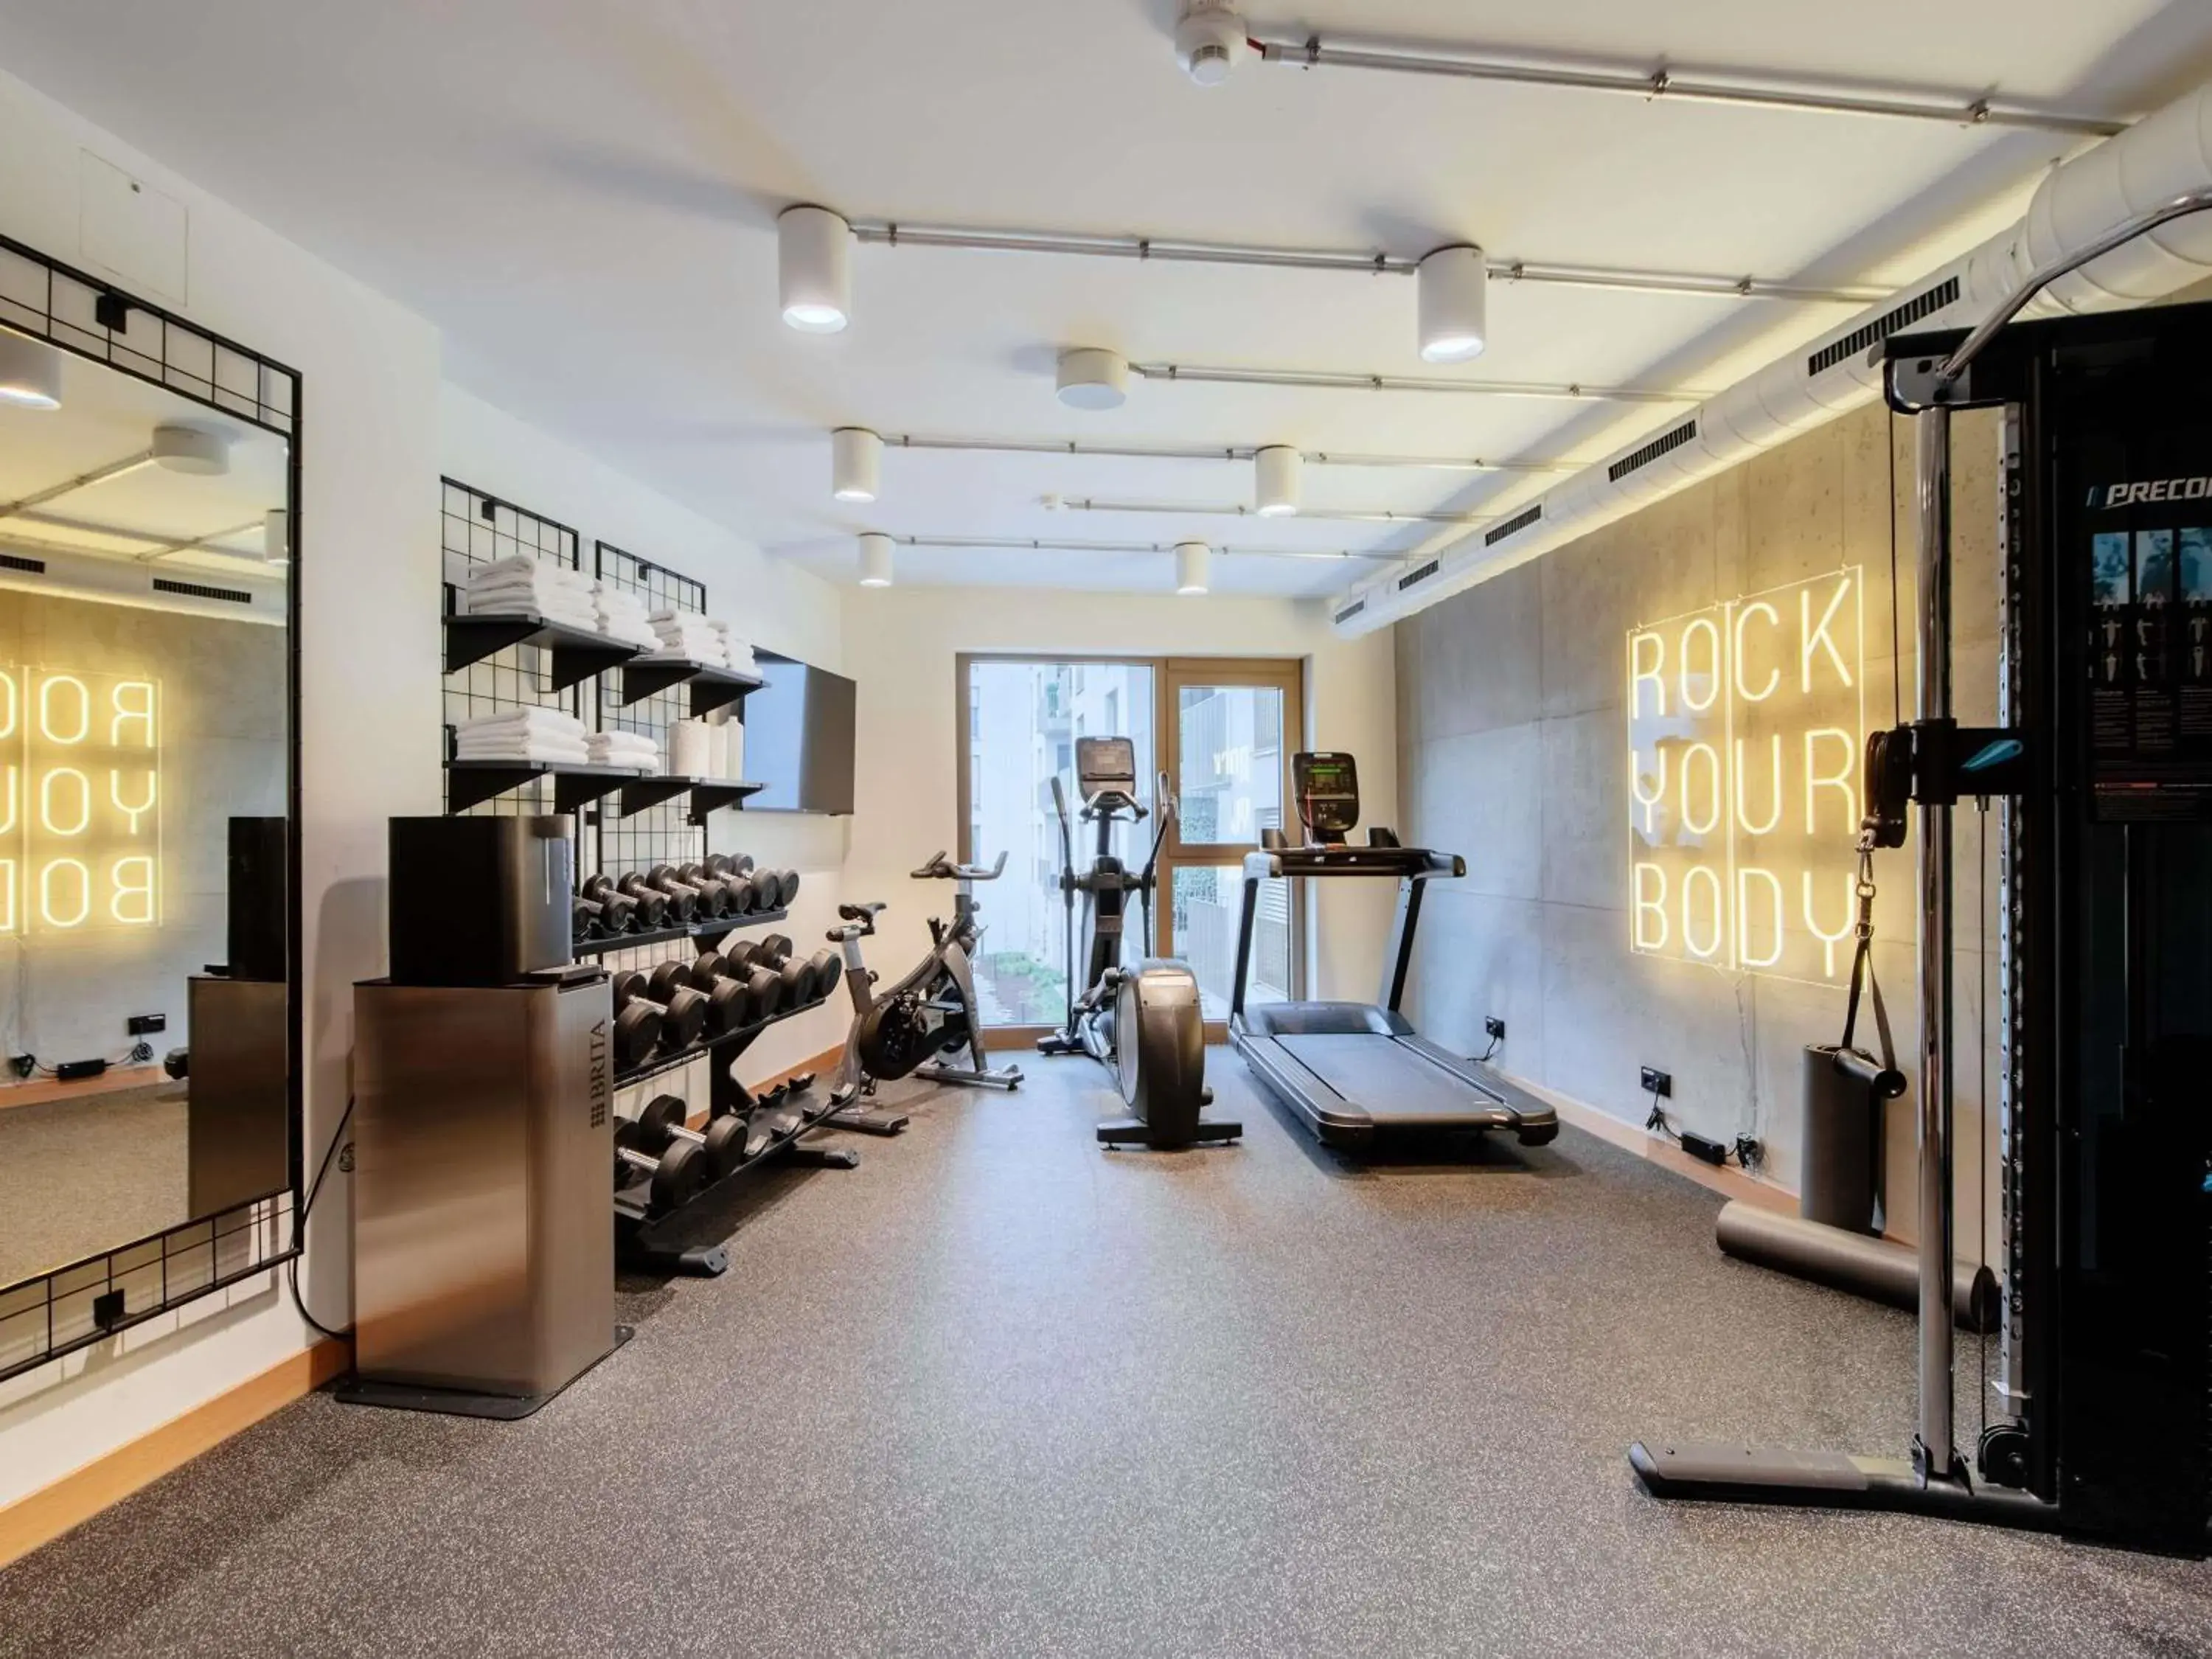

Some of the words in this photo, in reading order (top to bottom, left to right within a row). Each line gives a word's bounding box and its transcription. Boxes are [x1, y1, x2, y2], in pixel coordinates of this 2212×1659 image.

[2101, 476, 2212, 509] PRECO
[1631, 577, 1853, 720] ROCK
[1631, 728, 1857, 835] YOUR
[1634, 860, 1856, 978] BODY
[591, 1018, 605, 1099] BRITA
